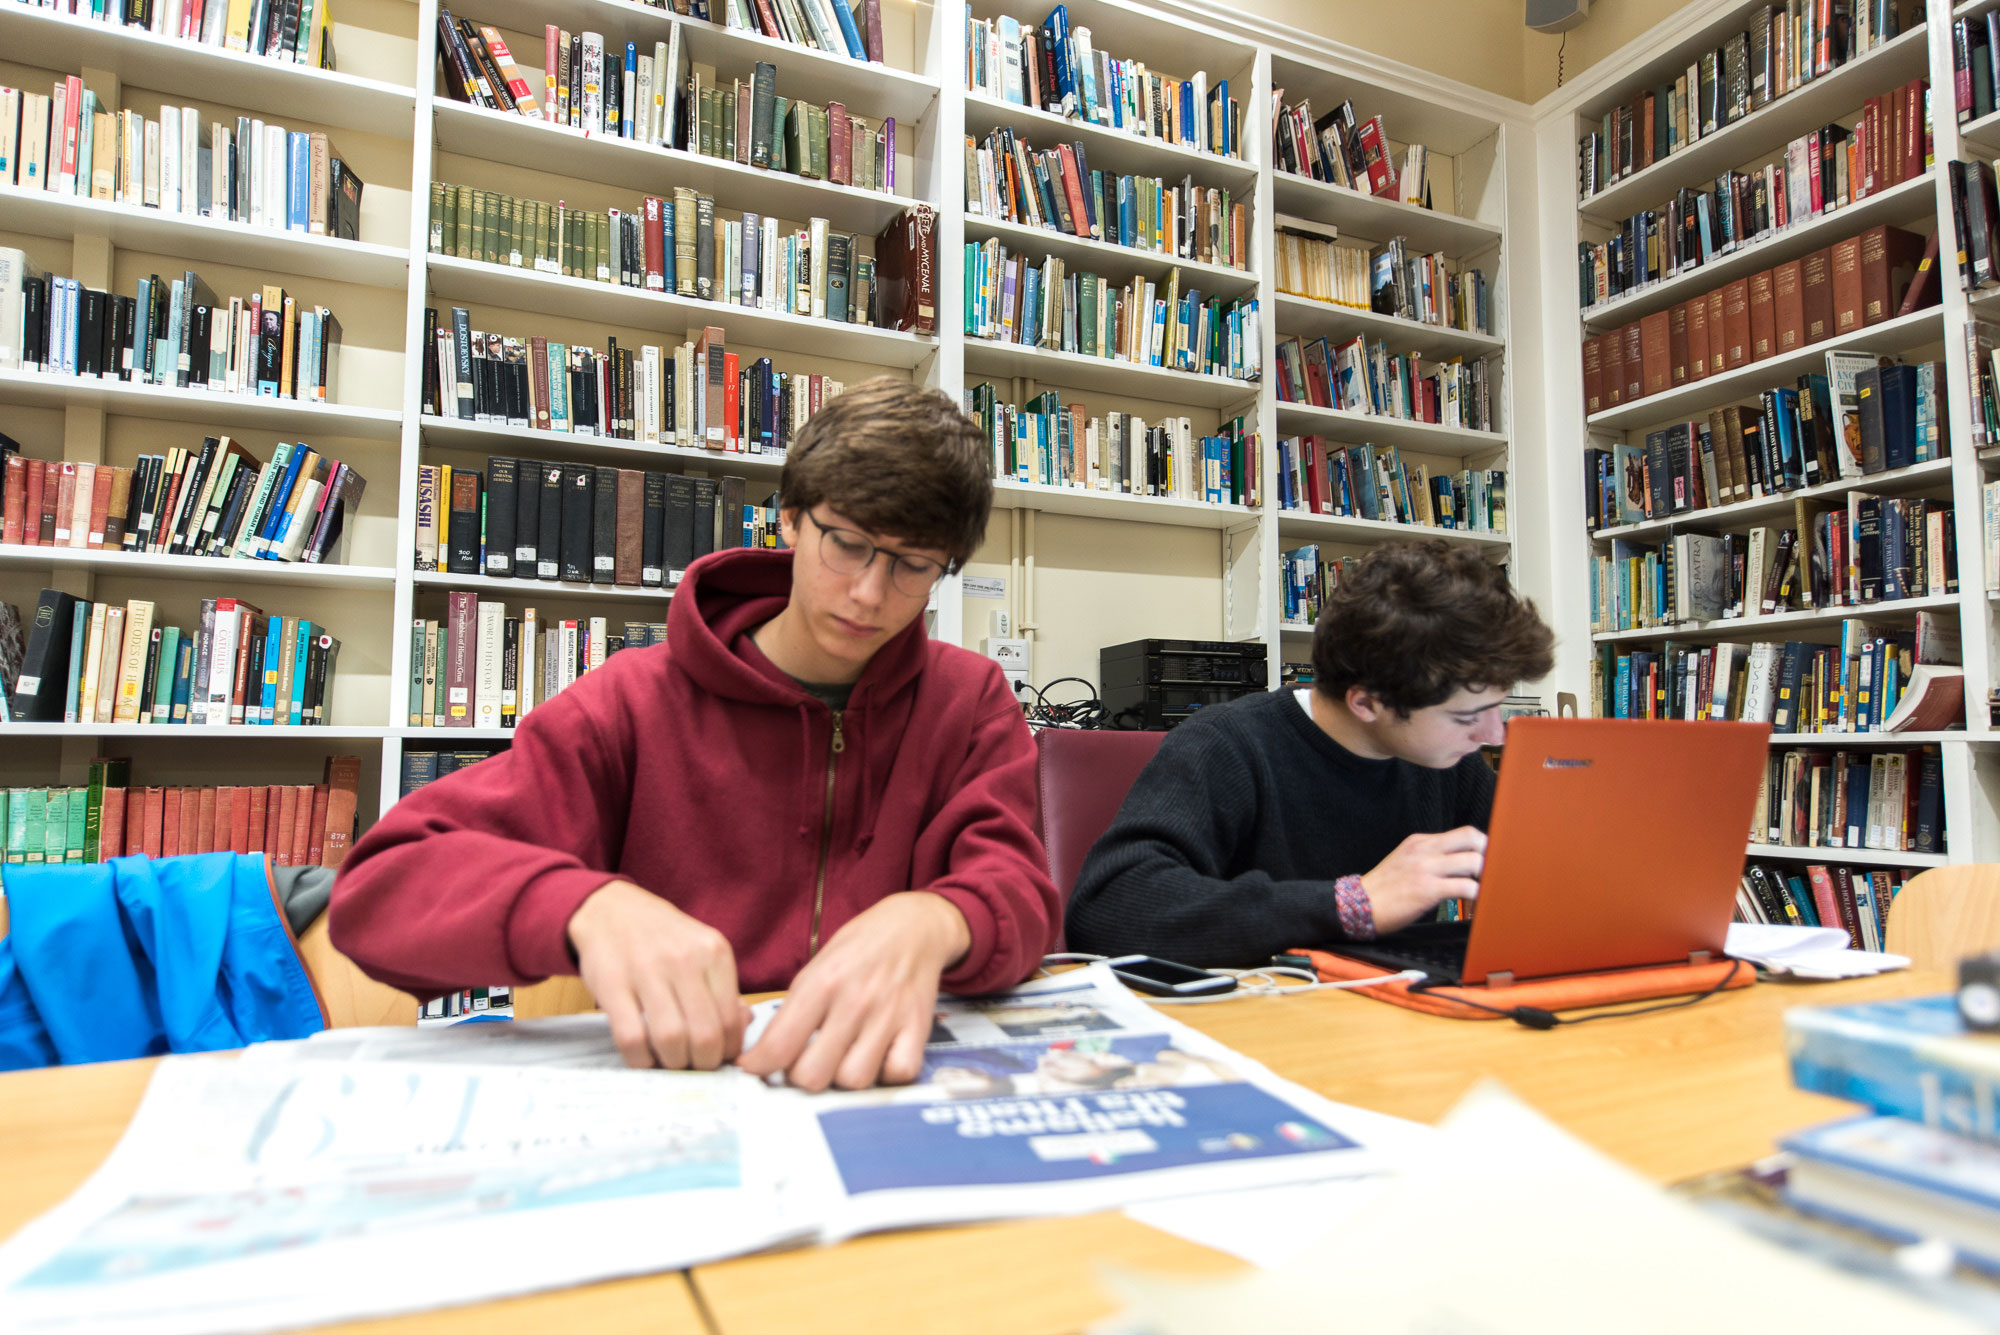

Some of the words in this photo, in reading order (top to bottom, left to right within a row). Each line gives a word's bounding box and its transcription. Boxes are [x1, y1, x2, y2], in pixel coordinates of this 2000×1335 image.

[560, 47, 569, 81] HOMER
[1049, 74, 1057, 91] Deus
[921, 247, 930, 293] MYCENAE
[264, 338, 276, 367] Borges
[459, 323, 470, 375] DOSTOEVSKY
[1766, 401, 1774, 421] SEARCH
[1768, 424, 1775, 432] OF
[271, 453, 283, 470] LATIN
[1221, 448, 1229, 466] Italy
[1771, 447, 1780, 471] WORLDS
[200, 471, 218, 506] READING
[264, 471, 276, 491] POETS
[258, 491, 268, 505] AND
[418, 468, 433, 528] MUSASHI
[192, 508, 205, 529] OVID
[250, 506, 263, 528] ROMAN
[1914, 516, 1922, 530] Jews
[244, 529, 254, 543] LIFE
[1752, 543, 1762, 573] CLEOPATRA
[1885, 545, 1893, 579] JERUSALEM
[1914, 547, 1922, 567] Roman
[1752, 574, 1760, 583] THE
[1915, 567, 1923, 585] World
[459, 597, 467, 609] The
[135, 607, 146, 628] THE
[458, 609, 466, 639] Timetables
[131, 629, 143, 656] ODES
[485, 615, 495, 648] WORLD
[216, 629, 228, 675] CATULLUS
[127, 658, 140, 671] OF
[238, 658, 246, 680] Shackleton
[283, 651, 291, 677] Shackleton
[484, 651, 494, 691] HISTORY
[236, 679, 244, 692] Bailey
[281, 676, 289, 692] Bailey
[1621, 684, 1629, 715] HOLLAND
[87, 806, 98, 831] LIVY
